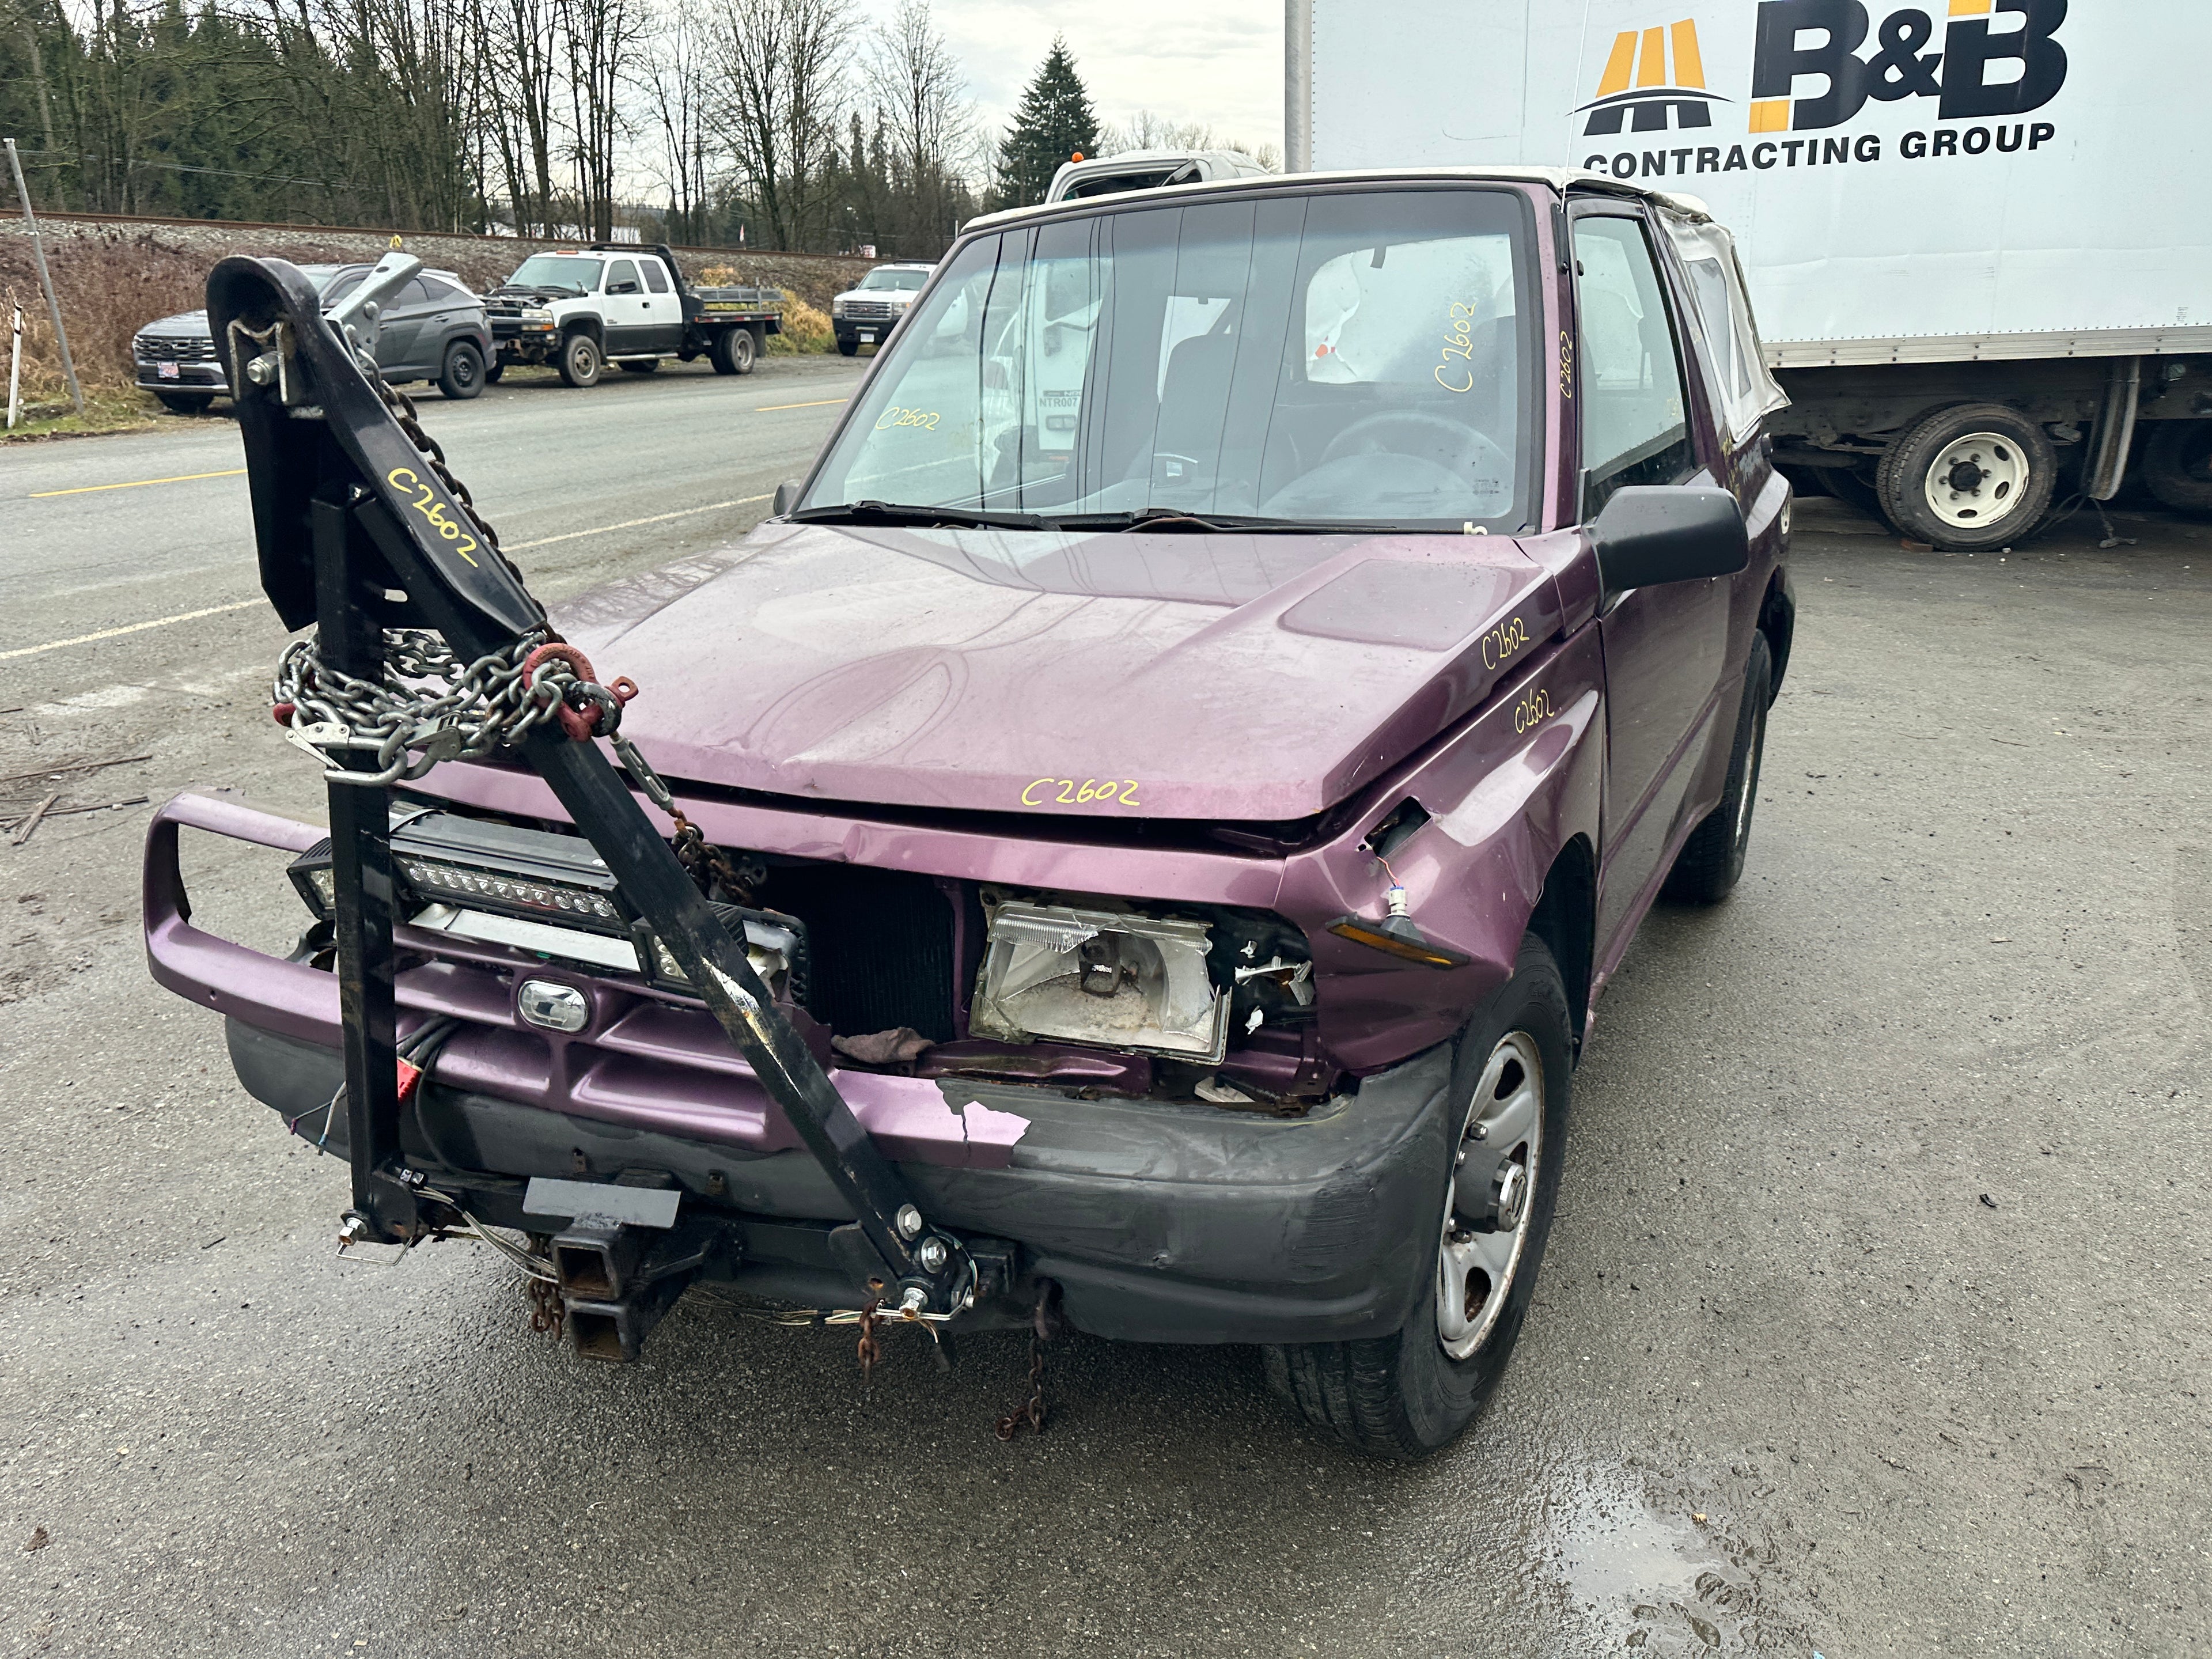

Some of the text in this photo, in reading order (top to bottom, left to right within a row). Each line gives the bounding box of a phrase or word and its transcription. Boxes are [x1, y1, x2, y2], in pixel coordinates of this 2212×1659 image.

[1749, 0, 2068, 133] B&B
[1584, 123, 2055, 179] CONTRACTING GROUP
[1434, 302, 1478, 393] C2602
[1560, 331, 1573, 399] C2602
[876, 407, 940, 430] C2602
[1039, 398, 1078, 407] NTR007
[388, 468, 478, 567] C2602
[1482, 617, 1530, 670] C2602
[1515, 688, 1555, 734] C2602
[1021, 778, 1140, 806] C2602
